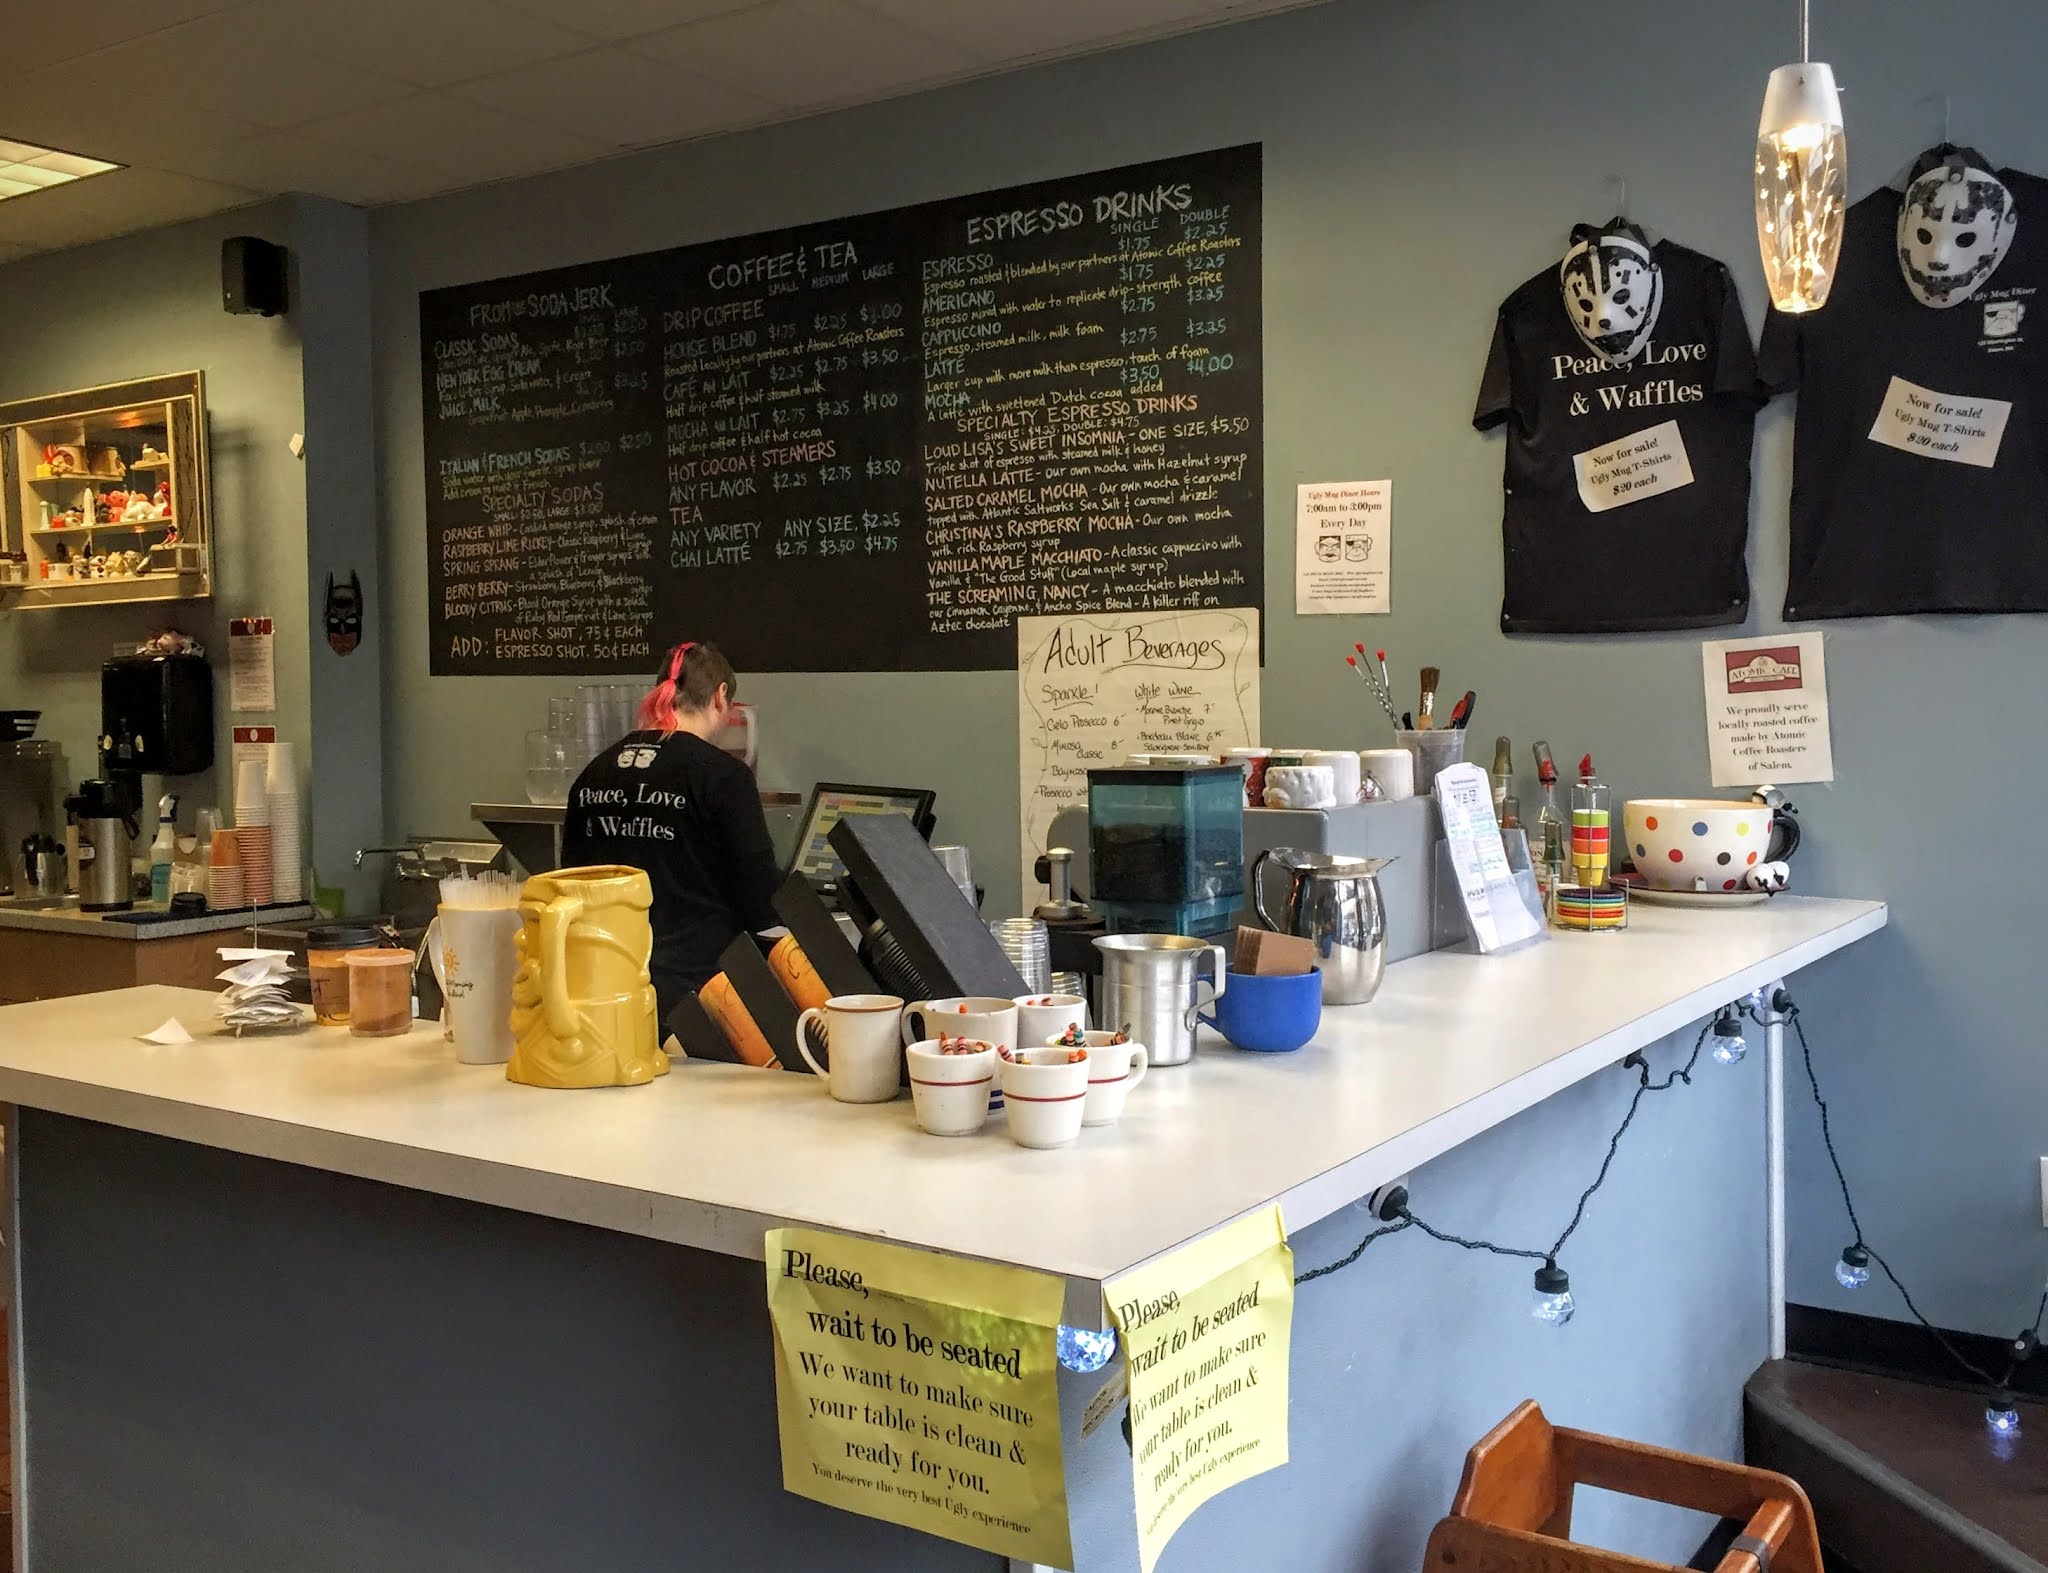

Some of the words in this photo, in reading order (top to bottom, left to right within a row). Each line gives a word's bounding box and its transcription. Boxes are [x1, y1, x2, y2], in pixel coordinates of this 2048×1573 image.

[967, 201, 1083, 245] ESPRESSO
[1093, 183, 1193, 223] DRINKS
[1110, 217, 1159, 235] SINGLE
[1180, 204, 1231, 225] DOUBLE
[709, 253, 793, 290] COFFEE
[798, 246, 807, 279] &
[815, 241, 858, 269] TEA
[922, 254, 994, 281] ESPRESSO
[470, 303, 511, 327] FROM
[527, 293, 568, 318] SODA
[569, 284, 614, 312] JERK
[663, 308, 702, 333] DRIP
[704, 299, 765, 326] COFFEE
[922, 290, 994, 314] AMERICANO
[921, 322, 1002, 347] CAPPUCCINO
[1642, 340, 1706, 365] Love
[1570, 392, 1589, 416] &
[1597, 379, 1703, 411] Waffles
[1906, 394, 1932, 410] Now
[1934, 403, 1953, 416] for
[1956, 408, 1983, 419] sale!
[957, 410, 1036, 432] SPECIALTY
[1048, 400, 1130, 423] ESPRESSO
[1136, 395, 1198, 415] DRINKS
[1895, 409, 1915, 425] Ugly
[1917, 416, 1939, 432] Mug
[1943, 423, 1986, 437] T-Shirts
[924, 443, 961, 460] LOUD
[963, 438, 1003, 456] LISA'S
[1010, 436, 1055, 453] SWEET
[1138, 427, 1166, 441] ONE
[1211, 416, 1249, 438] $5.50
[1907, 432, 1930, 446] $20
[1932, 438, 1959, 452] each
[668, 462, 697, 482] HOT
[701, 457, 747, 475] COCOA
[750, 454, 756, 473] &
[762, 440, 836, 466] STEAMERS
[1593, 455, 1614, 467] Now
[1616, 449, 1632, 460] for
[1634, 438, 1658, 453] sale!
[669, 484, 697, 503] ANY
[700, 478, 756, 500] FLAVOR
[773, 472, 808, 492] $2.25
[819, 465, 851, 486] $2.75
[866, 457, 901, 479] $3.50
[1591, 472, 1610, 484] Ugly
[1612, 466, 1632, 478] Mug
[1632, 452, 1672, 471] T-Shirts
[482, 491, 546, 512] SPECIALTY
[551, 482, 604, 504] SODAS
[924, 495, 974, 513] SALTED
[977, 490, 1036, 508] CARAMEL
[1040, 484, 1089, 502] MOCHA
[1308, 492, 1323, 500] Ugly
[1325, 491, 1339, 499] Mug
[1613, 482, 1632, 495] $20
[1634, 474, 1657, 489] each
[669, 506, 703, 525] TEA
[1307, 505, 1337, 513] 7:00am
[1350, 502, 1381, 512] 3:00pm
[443, 525, 484, 543] ORANGE
[670, 529, 700, 548] ANY
[704, 521, 761, 542] VARIETY
[784, 519, 812, 537] ANY
[862, 510, 901, 530] $2.25
[926, 523, 1003, 546] CHRISTINA'S
[1008, 516, 1082, 537] RASPBERRY
[1088, 512, 1134, 533] MOCHA
[1320, 519, 1345, 530] Every
[1349, 518, 1366, 527] Day
[671, 551, 701, 568] CHAI
[776, 539, 808, 558] $2.75
[820, 537, 855, 556] $3.50
[864, 535, 898, 554] $4.75
[927, 558, 979, 575] VANILLA
[981, 554, 1025, 570] MAPLE
[1031, 548, 1102, 566] MACCHIATO
[443, 561, 481, 577] SPRING
[484, 556, 519, 572] SPRANG
[927, 591, 951, 605] THE
[1043, 584, 1089, 598] NANCY
[445, 603, 476, 619] BLOODY
[451, 636, 488, 657] ADD:
[495, 627, 541, 641] FLAVOR
[615, 625, 643, 638] EACH
[496, 645, 555, 659] ESPRESSO
[622, 642, 649, 656] EACH
[1045, 628, 1112, 673] Adult
[1122, 625, 1225, 671] Beverages
[1732, 668, 1767, 680] ATOMIC
[1135, 683, 1160, 702] White
[1719, 720, 1749, 730] locally
[1753, 717, 1786, 728] roasted
[1789, 716, 1818, 725] coffee
[1726, 706, 1742, 715] We
[1745, 703, 1780, 716] proudly
[1784, 703, 1808, 711] serve
[1731, 734, 1756, 742] made
[1758, 732, 1768, 742] by
[1772, 731, 1807, 740] Atomic
[1733, 747, 1763, 756] Coffee
[1766, 745, 1806, 754] Roasters
[1748, 762, 1758, 770] of
[1760, 761, 1792, 769] Salem.
[579, 787, 628, 807] Peace,
[635, 784, 686, 809] Love
[599, 816, 675, 840] Waffles
[783, 1249, 869, 1299] Please,
[1118, 1291, 1180, 1333] Please,
[1131, 1333, 1168, 1377] wait
[1172, 1327, 1186, 1353] to
[1192, 1315, 1208, 1342] be
[1212, 1281, 1259, 1329] seated
[807, 1310, 864, 1341] wait
[871, 1318, 896, 1347] to
[903, 1324, 933, 1356] be
[941, 1341, 1022, 1379] seated
[1150, 1375, 1180, 1411] want
[1184, 1368, 1196, 1389] to
[1200, 1346, 1232, 1379] make
[1235, 1331, 1266, 1357] sure
[799, 1351, 834, 1379] We
[842, 1365, 892, 1391] want
[900, 1374, 919, 1396] to
[927, 1383, 983, 1413] make
[989, 1400, 1034, 1428] sure
[1161, 1406, 1190, 1443] table
[1195, 1396, 1204, 1419] is
[1208, 1377, 1241, 1409] clean
[1247, 1364, 1258, 1388] &
[809, 1397, 857, 1419] your
[864, 1402, 915, 1433] table
[923, 1415, 939, 1440] is
[946, 1424, 1002, 1458] clean
[1009, 1440, 1026, 1465] &
[846, 1442, 903, 1473] ready
[911, 1451, 941, 1479] for
[948, 1466, 990, 1496] you.
[1154, 1451, 1181, 1492] ready
[1185, 1434, 1203, 1462] for
[1206, 1420, 1232, 1453] you.
[812, 1462, 832, 1478] You
[834, 1470, 873, 1489] deserve
[876, 1479, 894, 1494] the
[896, 1486, 919, 1503] very
[921, 1490, 941, 1508] best
[945, 1498, 969, 1520] Ugly
[972, 1508, 1031, 1534] experience
